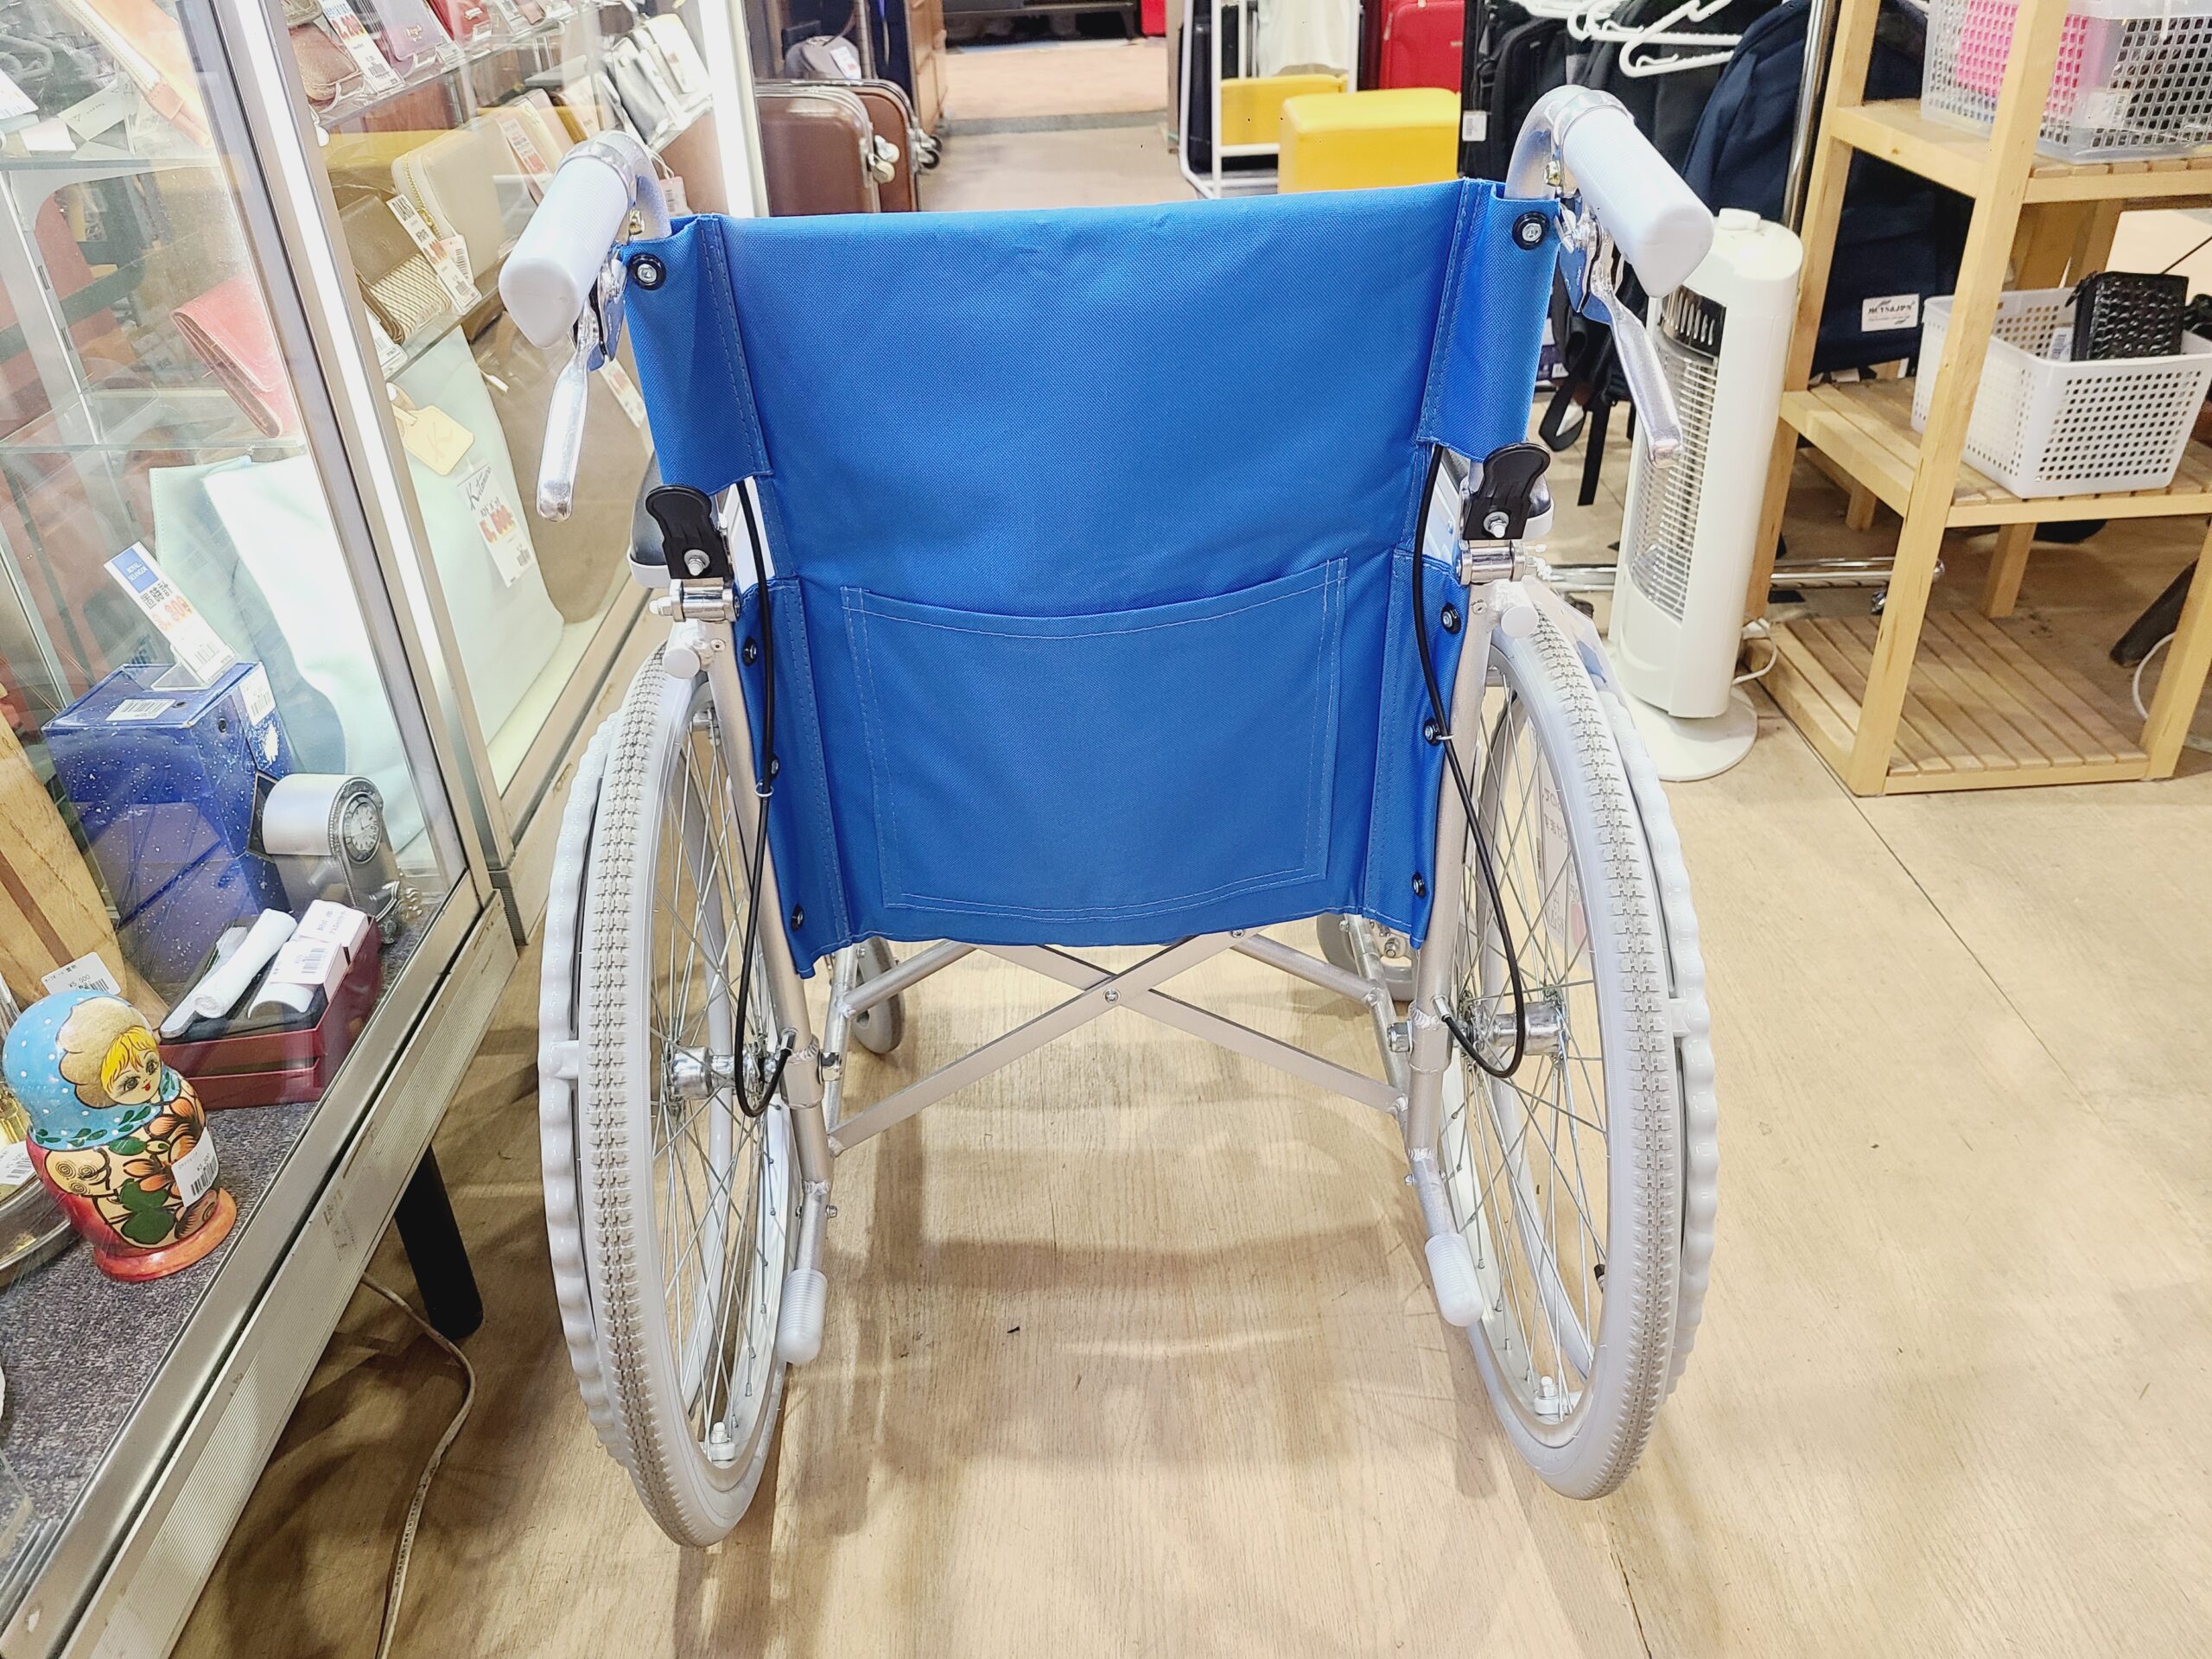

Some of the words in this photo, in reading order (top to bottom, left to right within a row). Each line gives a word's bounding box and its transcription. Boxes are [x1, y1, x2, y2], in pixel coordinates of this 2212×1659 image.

[391, 197, 416, 221] DAKS
[141, 580, 173, 609] 置時計
